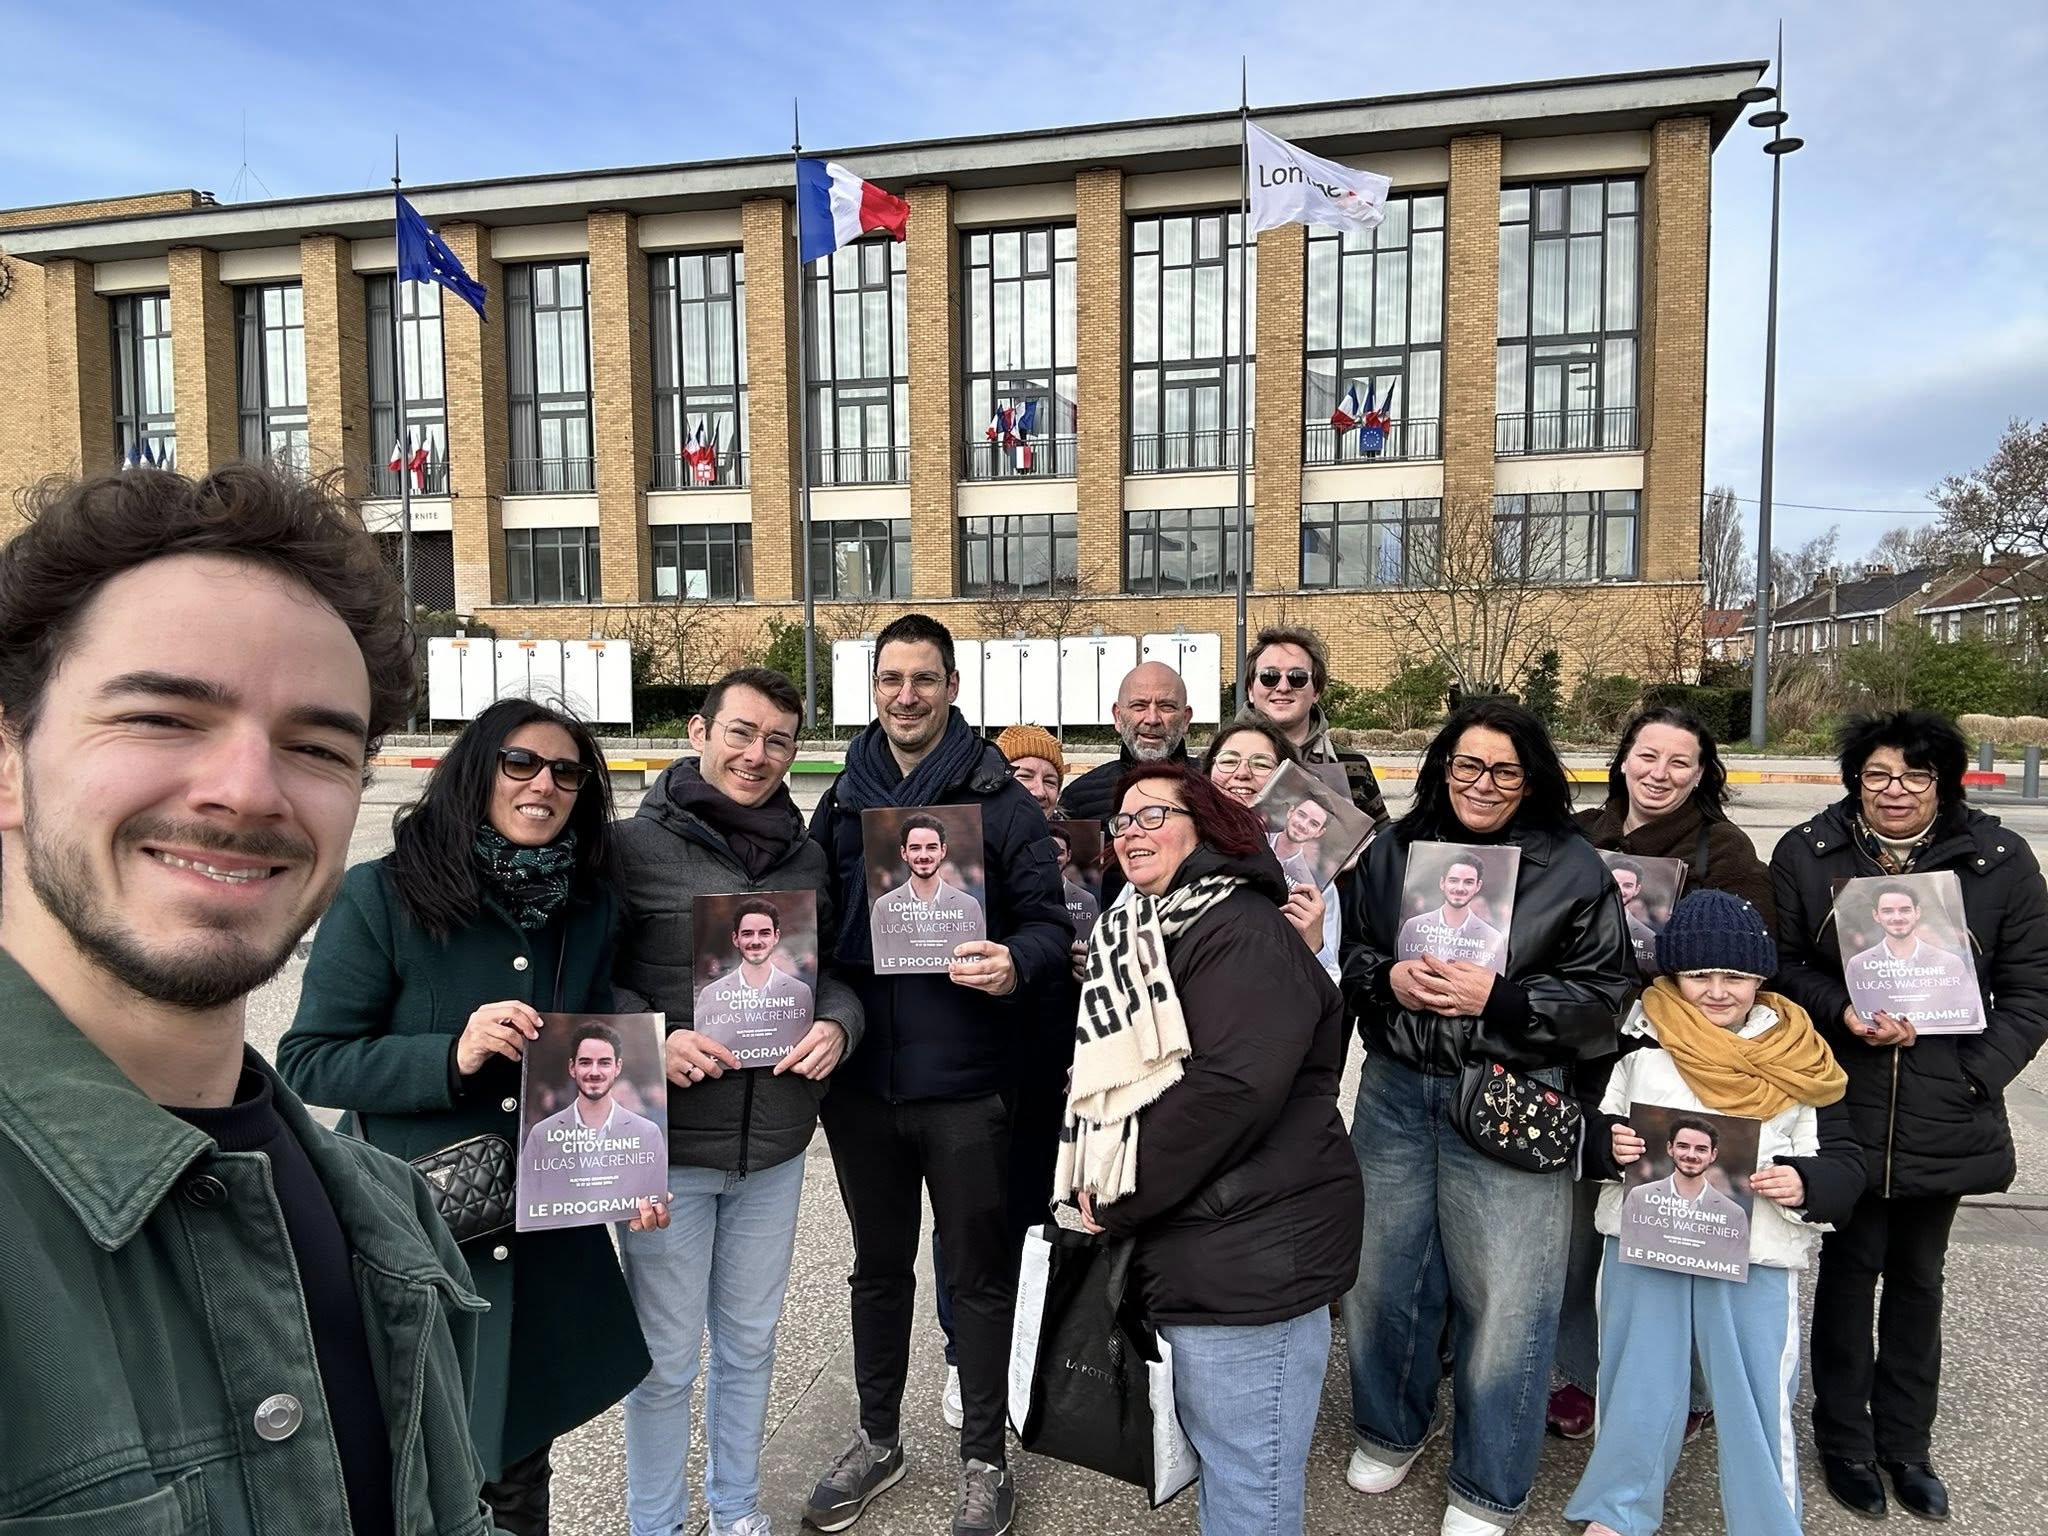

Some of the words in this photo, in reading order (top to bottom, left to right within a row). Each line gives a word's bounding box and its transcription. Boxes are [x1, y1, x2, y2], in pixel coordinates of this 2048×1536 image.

[530, 650, 535, 658] 4
[599, 650, 604, 658] 6
[1184, 645, 1197, 653] 10
[888, 902, 928, 912] LOMME
[901, 910, 964, 920] CITOYENNE
[880, 923, 914, 934] LUCAS
[916, 922, 976, 933] WACRENIER
[1416, 924, 1455, 936] LOMME
[1426, 934, 1486, 948] CITOYENNE
[1405, 943, 1434, 954] LUCAS
[1438, 946, 1496, 962] WACRENIER
[881, 958, 896, 967] LE
[1863, 960, 1906, 970] LOMME
[1878, 966, 1946, 978] CITOYENNE
[1856, 980, 1892, 990] LUCAS
[1894, 977, 1960, 989] WACRENIER
[716, 989, 759, 1001] LOMME
[729, 997, 795, 1010] CITOYENNE
[705, 1014, 741, 1025] LUCAS
[745, 1008, 806, 1022] WACRENIER
[547, 1128, 597, 1142] LOMME
[562, 1137, 641, 1154] CITOYENNE
[534, 1157, 575, 1171] LUCAS
[580, 1152, 655, 1169] WACRENIER
[1645, 1194, 1689, 1209] LOMME
[529, 1204, 548, 1217] LE
[1658, 1206, 1728, 1224] CITOYENNE
[1632, 1214, 1669, 1228] LUCAS
[1673, 1218, 1739, 1239] WACRENIER
[1627, 1247, 1643, 1259] LE
[1647, 1250, 1740, 1275] PROGRAMME
[1066, 1358, 1078, 1370] LA
